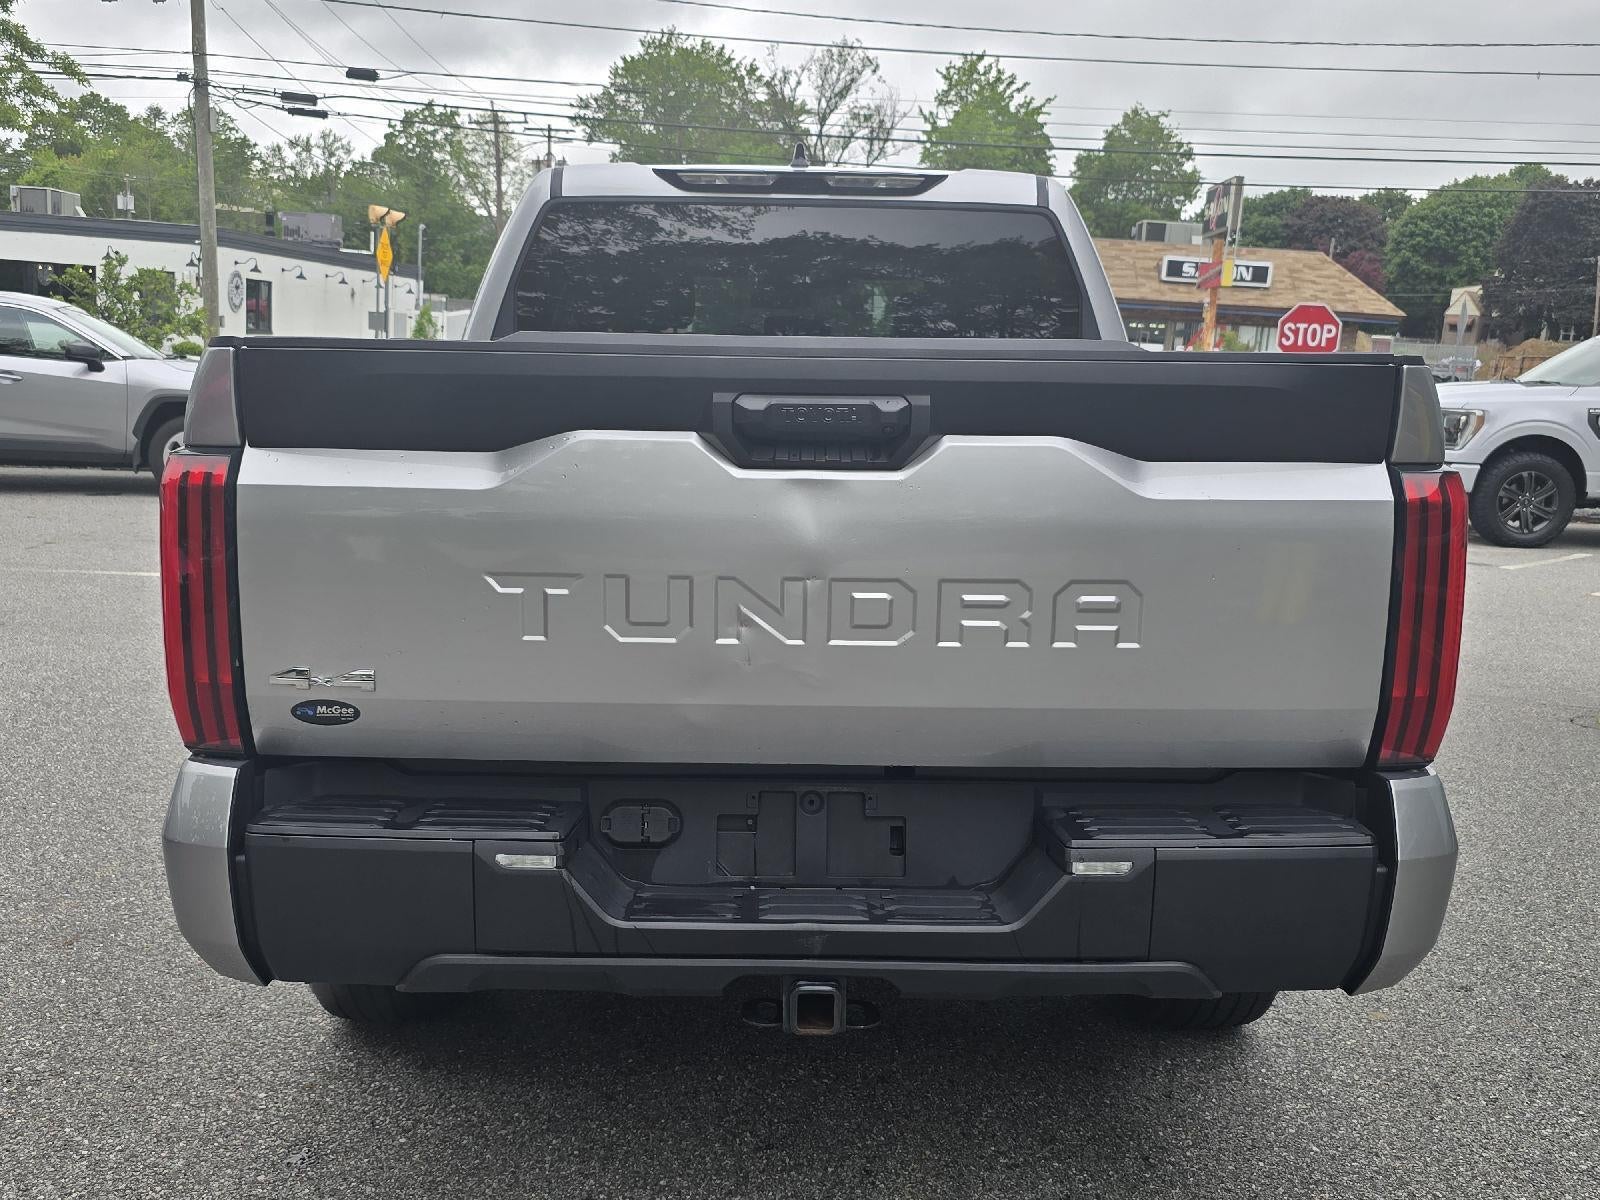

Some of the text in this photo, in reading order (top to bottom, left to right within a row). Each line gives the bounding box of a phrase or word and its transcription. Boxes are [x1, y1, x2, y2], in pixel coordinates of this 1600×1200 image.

[1281, 322, 1337, 347] STOP
[781, 406, 862, 424] TOYOTA
[483, 573, 1143, 649] TUNDRA
[316, 705, 355, 714] McGee
